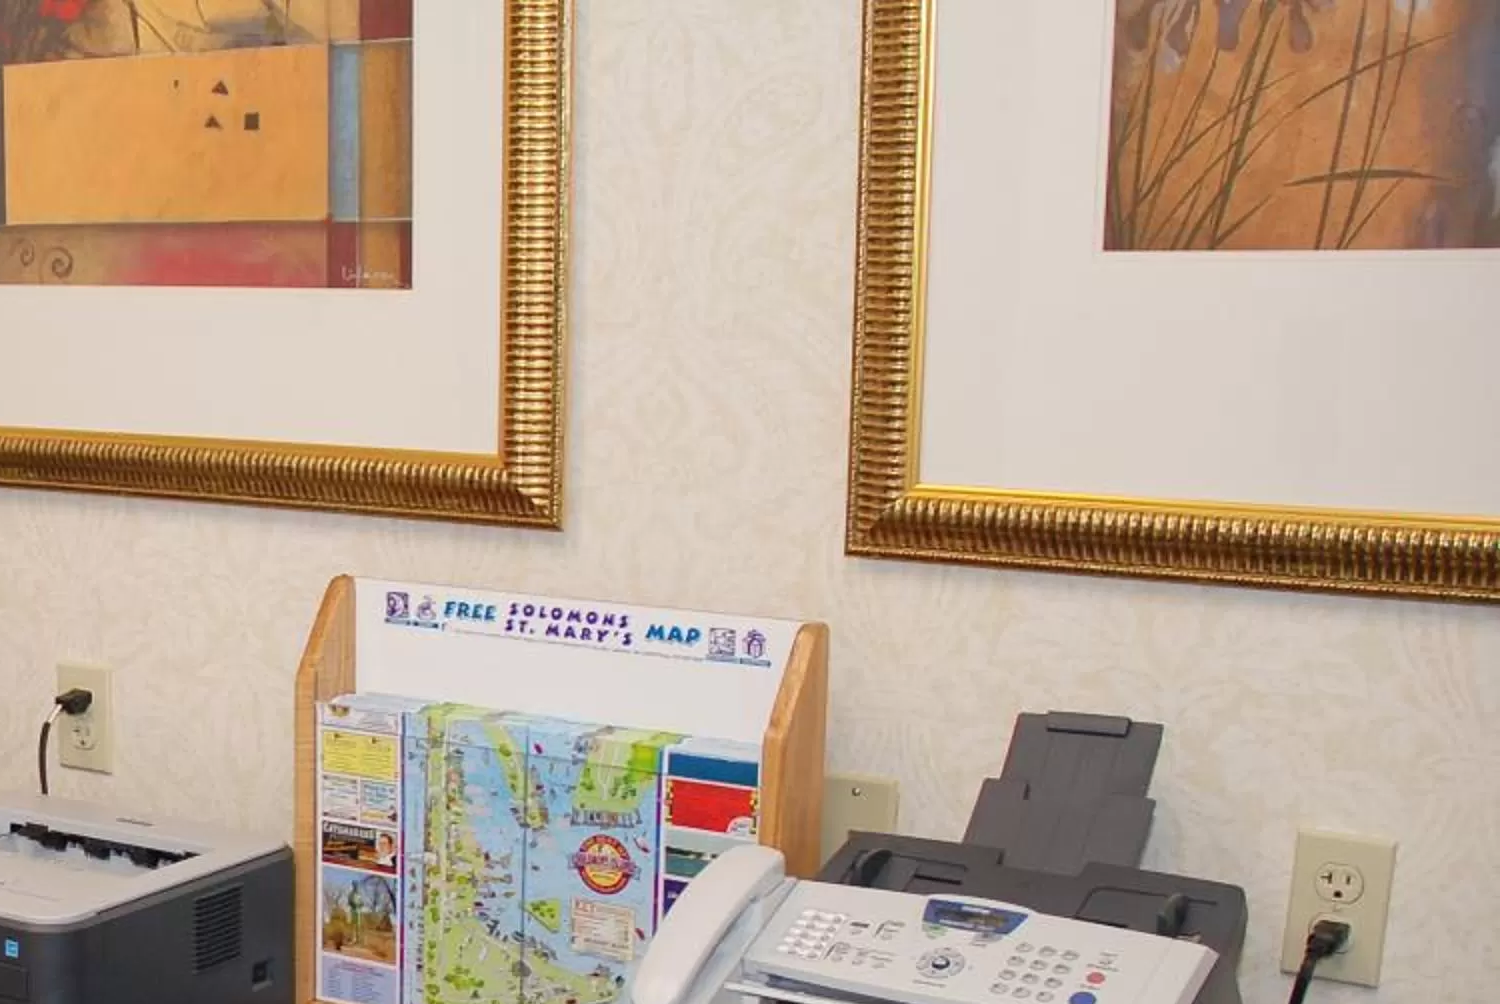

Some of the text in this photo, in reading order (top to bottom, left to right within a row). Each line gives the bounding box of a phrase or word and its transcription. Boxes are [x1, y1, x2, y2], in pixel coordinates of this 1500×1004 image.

[443, 600, 497, 621] FREE
[509, 602, 629, 628] SOLOMONS
[505, 618, 633, 645] ST. MARY'S
[645, 623, 702, 645] MAP
